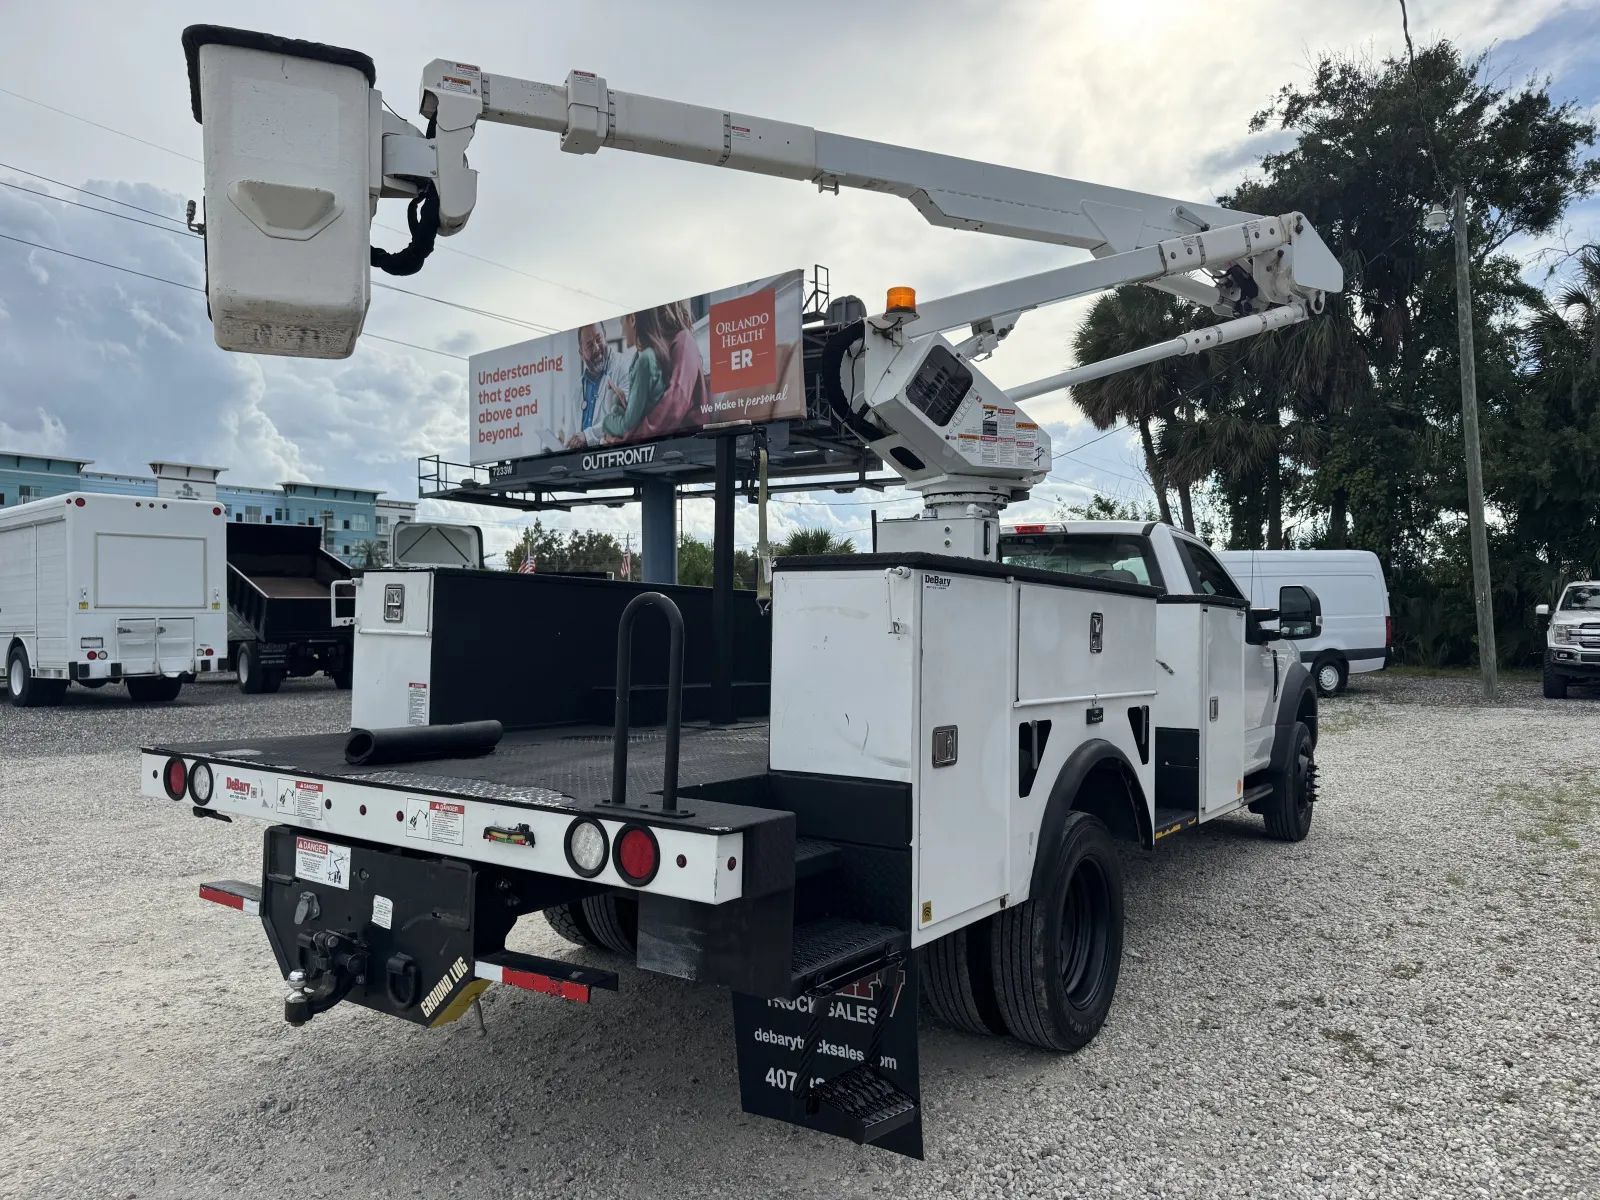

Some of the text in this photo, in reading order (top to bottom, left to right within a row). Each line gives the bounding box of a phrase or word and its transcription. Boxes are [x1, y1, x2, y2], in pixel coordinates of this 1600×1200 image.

[715, 313, 769, 335] ORLANDO
[722, 329, 763, 348] HEALTH
[478, 355, 563, 385] Understanding
[731, 348, 753, 371] ER
[478, 384, 531, 405] that goes
[700, 384, 788, 415] We Make It personal
[478, 399, 538, 424] above and
[478, 422, 523, 445] beyond.
[925, 575, 951, 586] DeBary
[226, 777, 251, 795] DeBary
[303, 842, 327, 854] DANGER
[420, 956, 469, 1018] GROUND LUG
